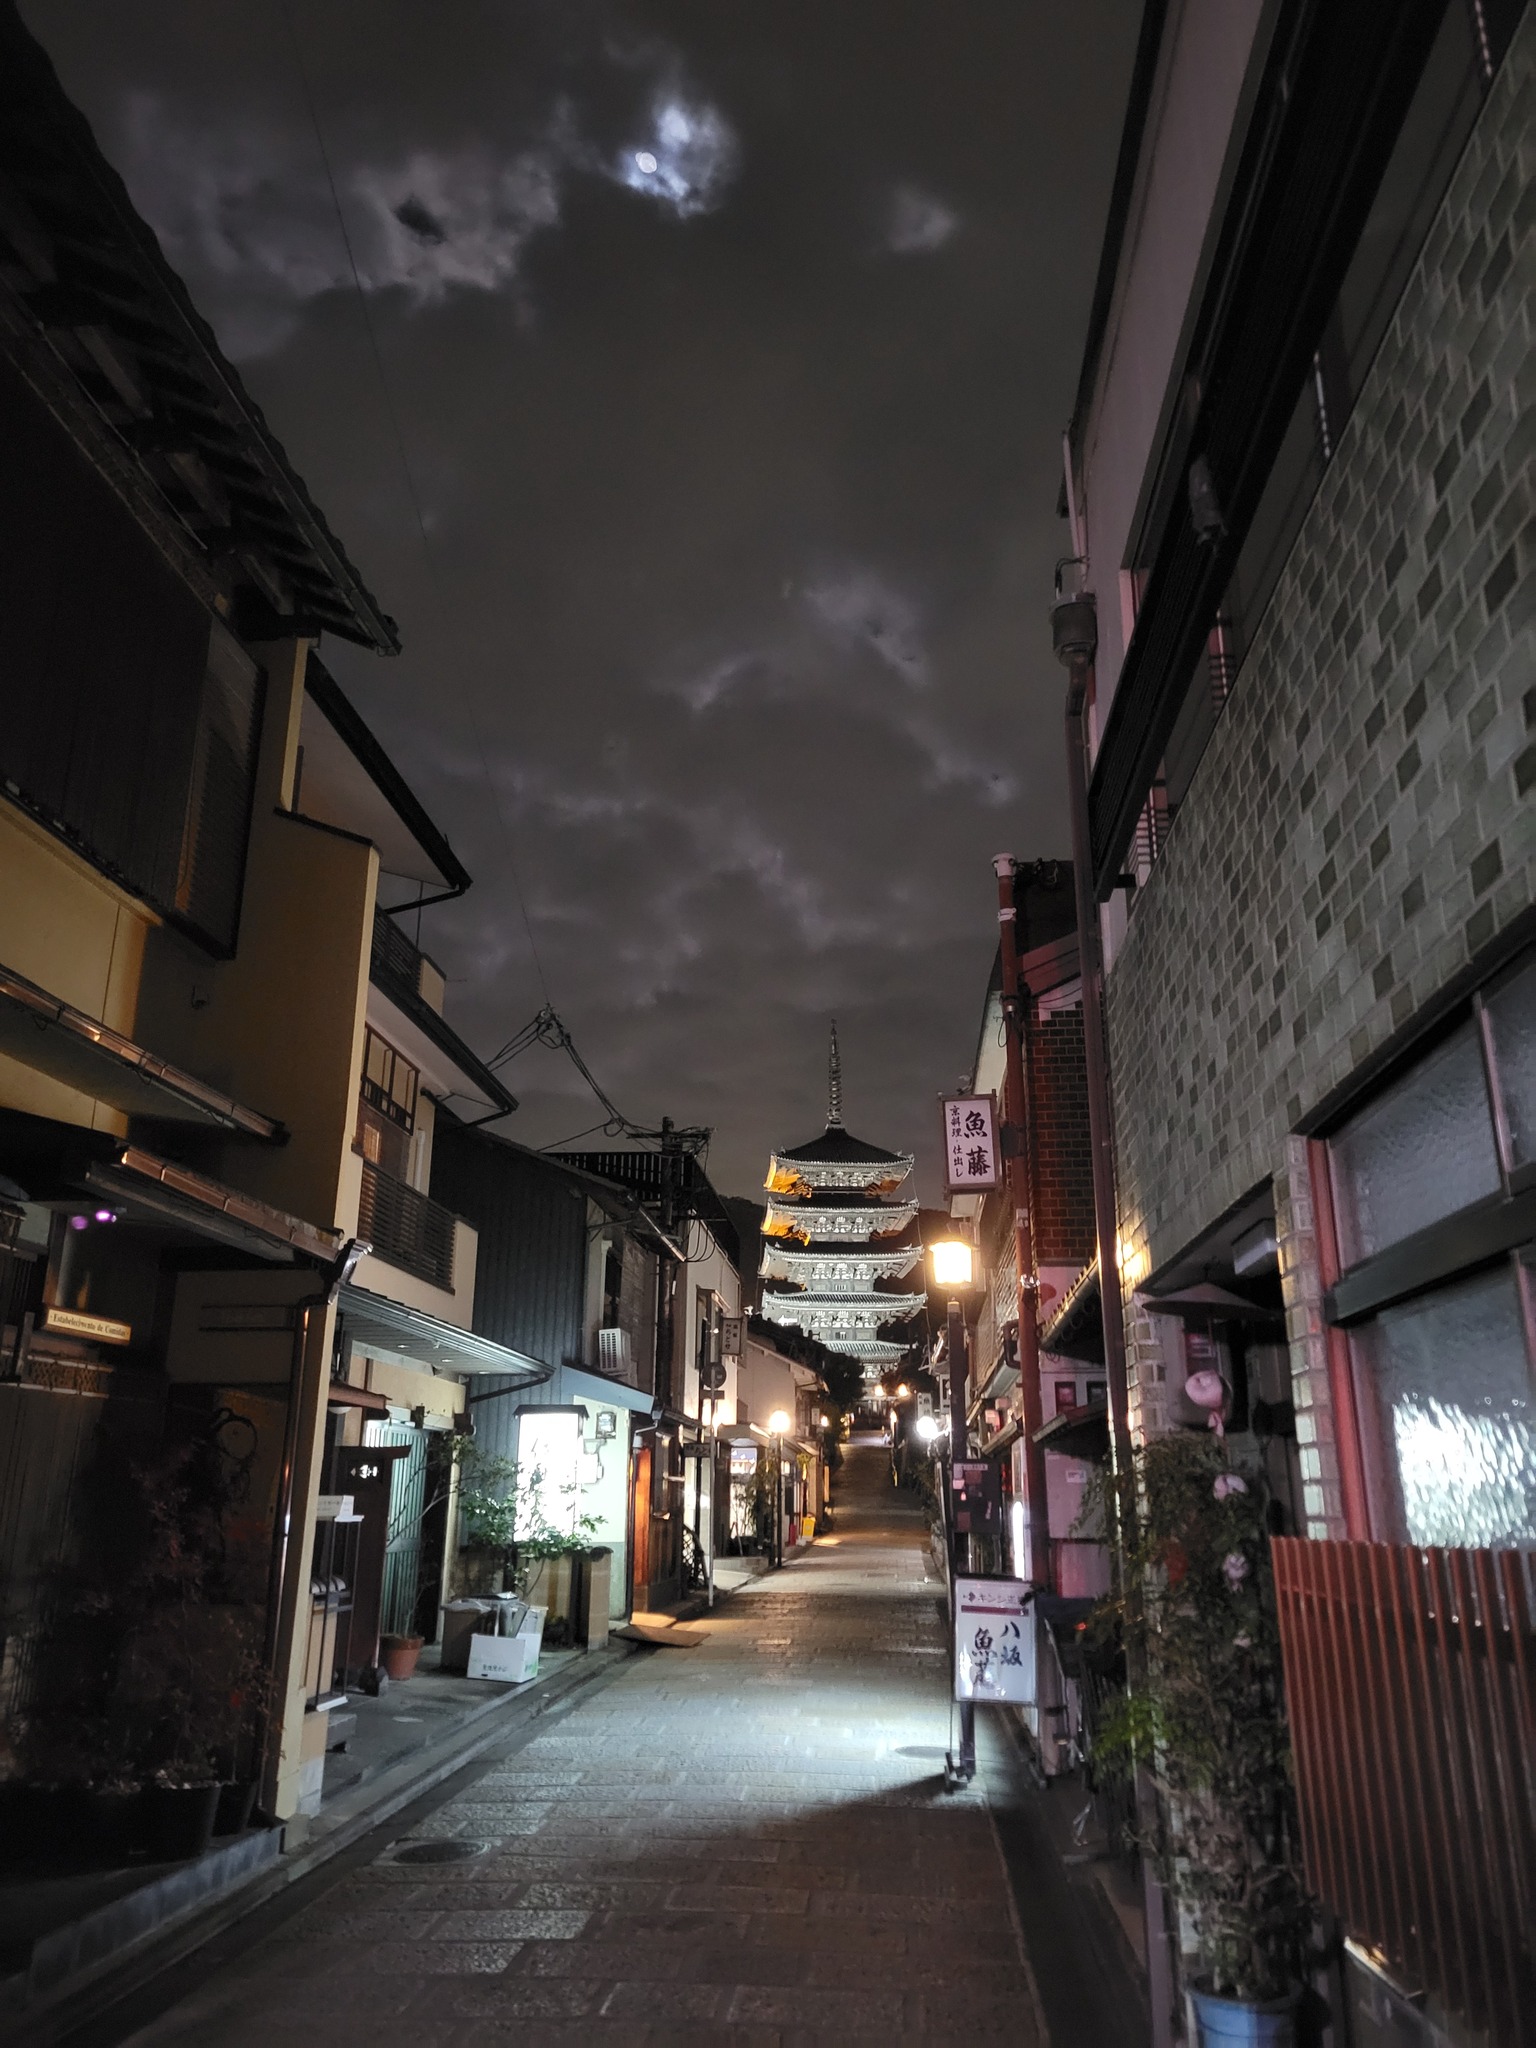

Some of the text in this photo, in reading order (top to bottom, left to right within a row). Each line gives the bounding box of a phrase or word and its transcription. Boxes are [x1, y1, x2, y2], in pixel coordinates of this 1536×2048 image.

[963, 1110, 991, 1176] 魚藤
[97, 1324, 103, 1332] de
[977, 1593, 1025, 1606] キンシ正
[1000, 1621, 1024, 1668] 八坂
